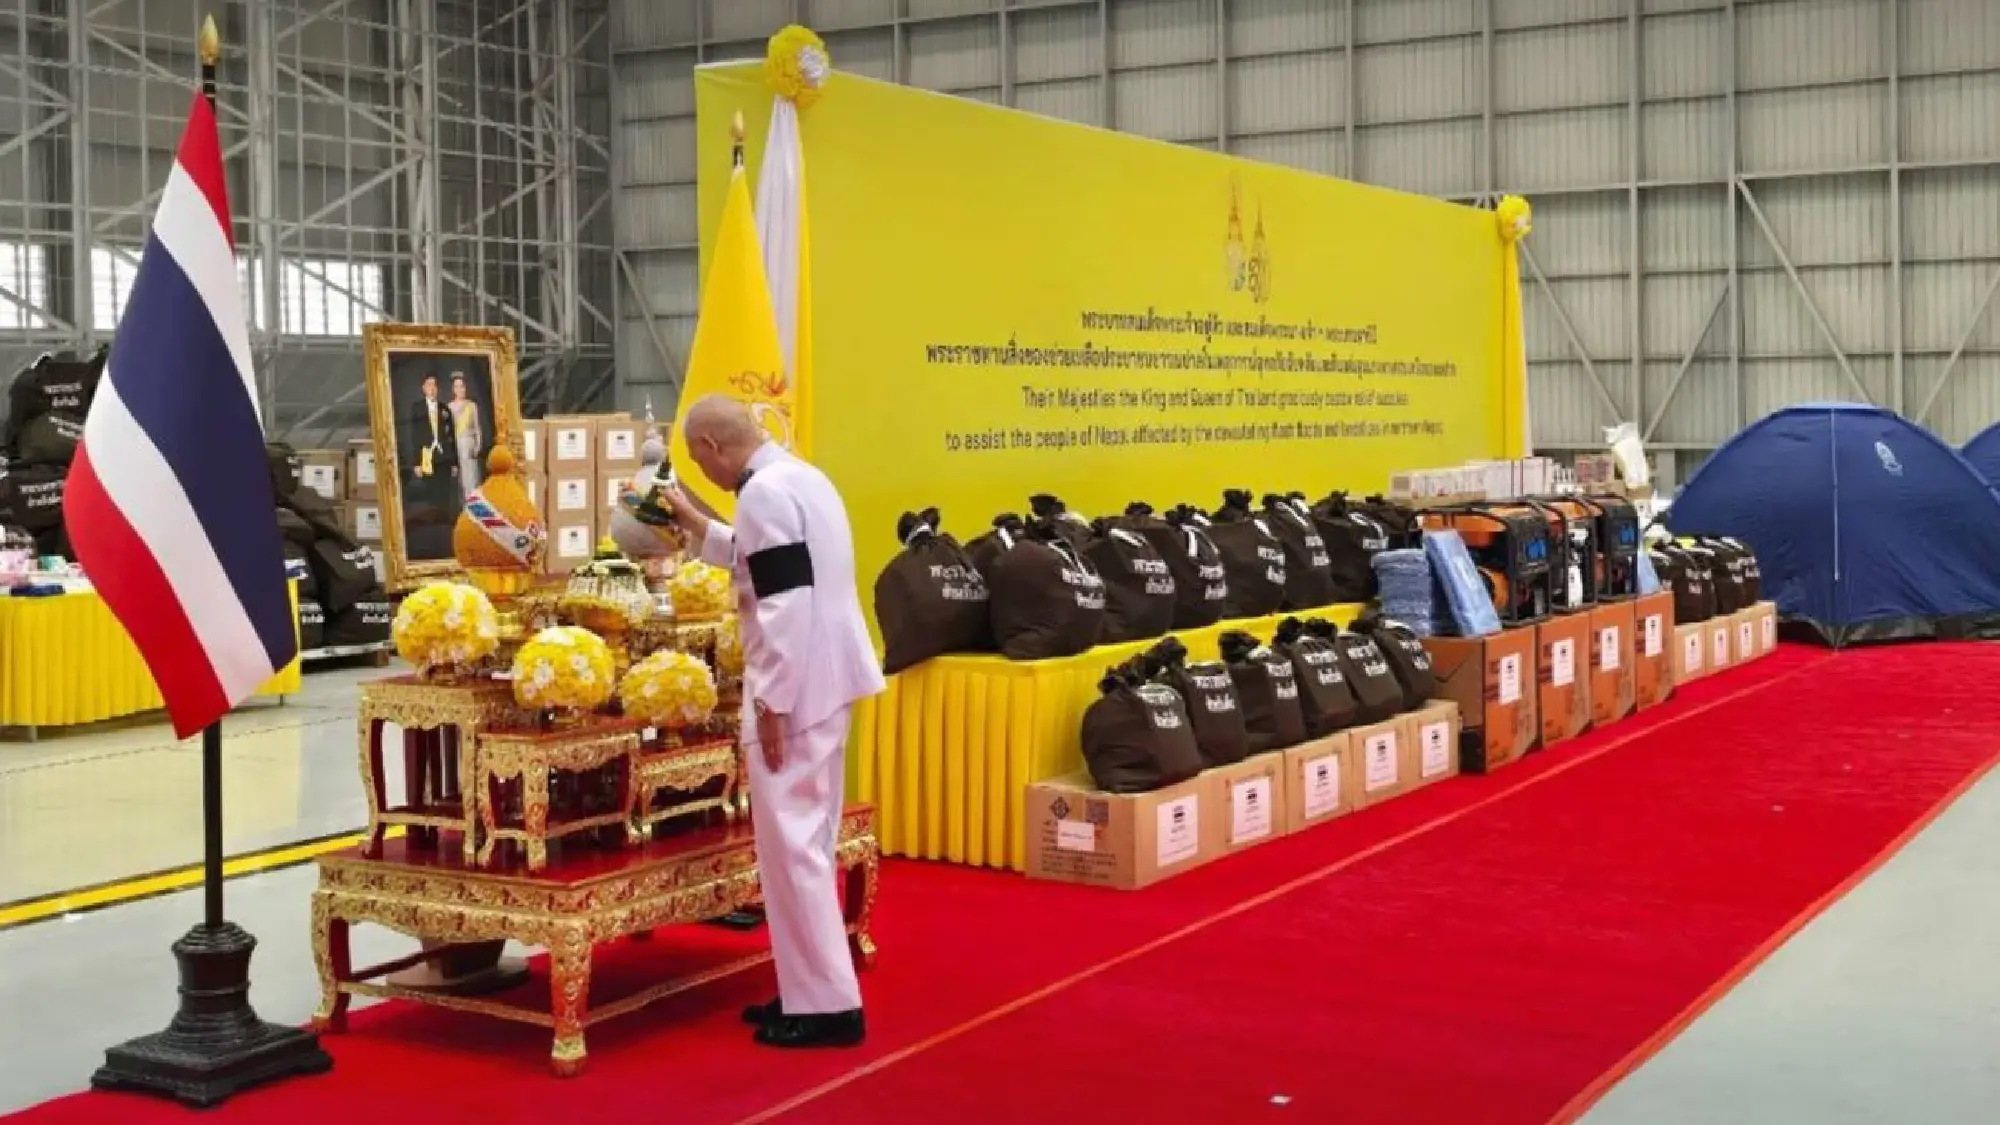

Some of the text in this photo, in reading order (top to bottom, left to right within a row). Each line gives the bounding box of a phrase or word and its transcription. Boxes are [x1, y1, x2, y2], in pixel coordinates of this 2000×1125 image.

[945, 429, 960, 450] to
[964, 427, 1006, 450] assist
[1010, 426, 1032, 448] the
